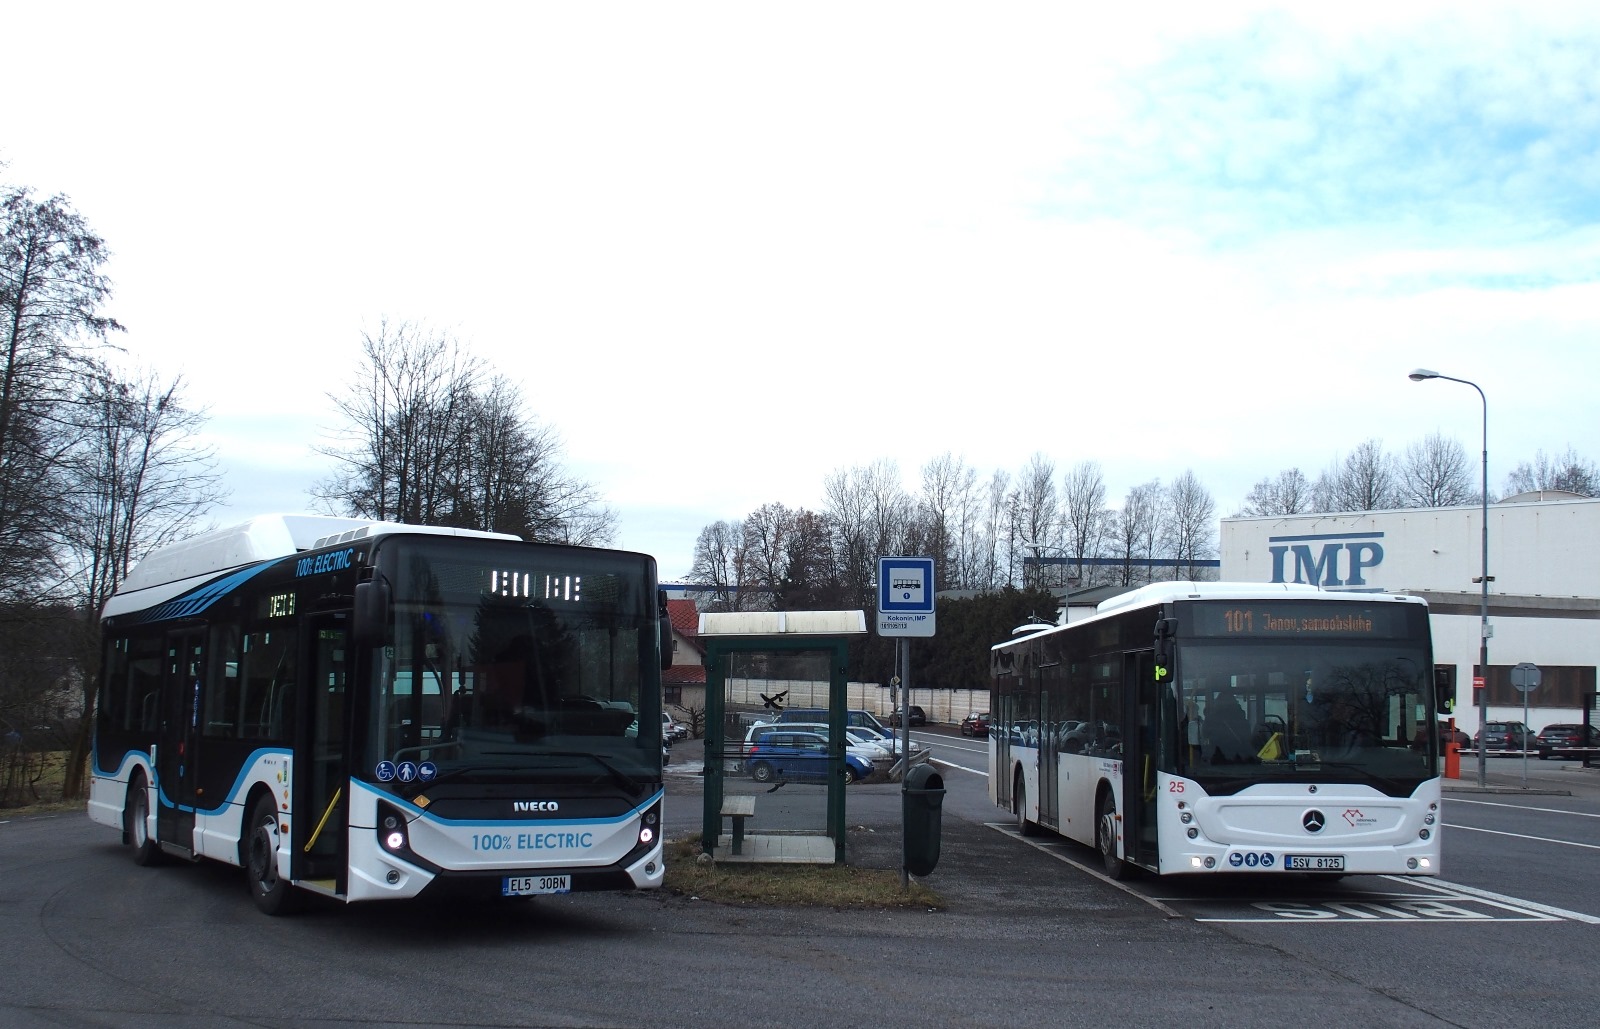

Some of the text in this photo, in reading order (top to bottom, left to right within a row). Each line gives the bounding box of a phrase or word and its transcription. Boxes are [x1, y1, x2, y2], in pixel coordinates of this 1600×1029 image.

[295, 548, 354, 577] 100% ELECTRIC
[1268, 542, 1384, 586] IMP
[1225, 610, 1253, 632] 101
[1169, 781, 1185, 793] 25
[513, 801, 559, 812] IVECO
[472, 832, 593, 850] 100% ELECTRIC
[1293, 857, 1340, 868] 5SV 8125
[511, 878, 532, 892] EL5
